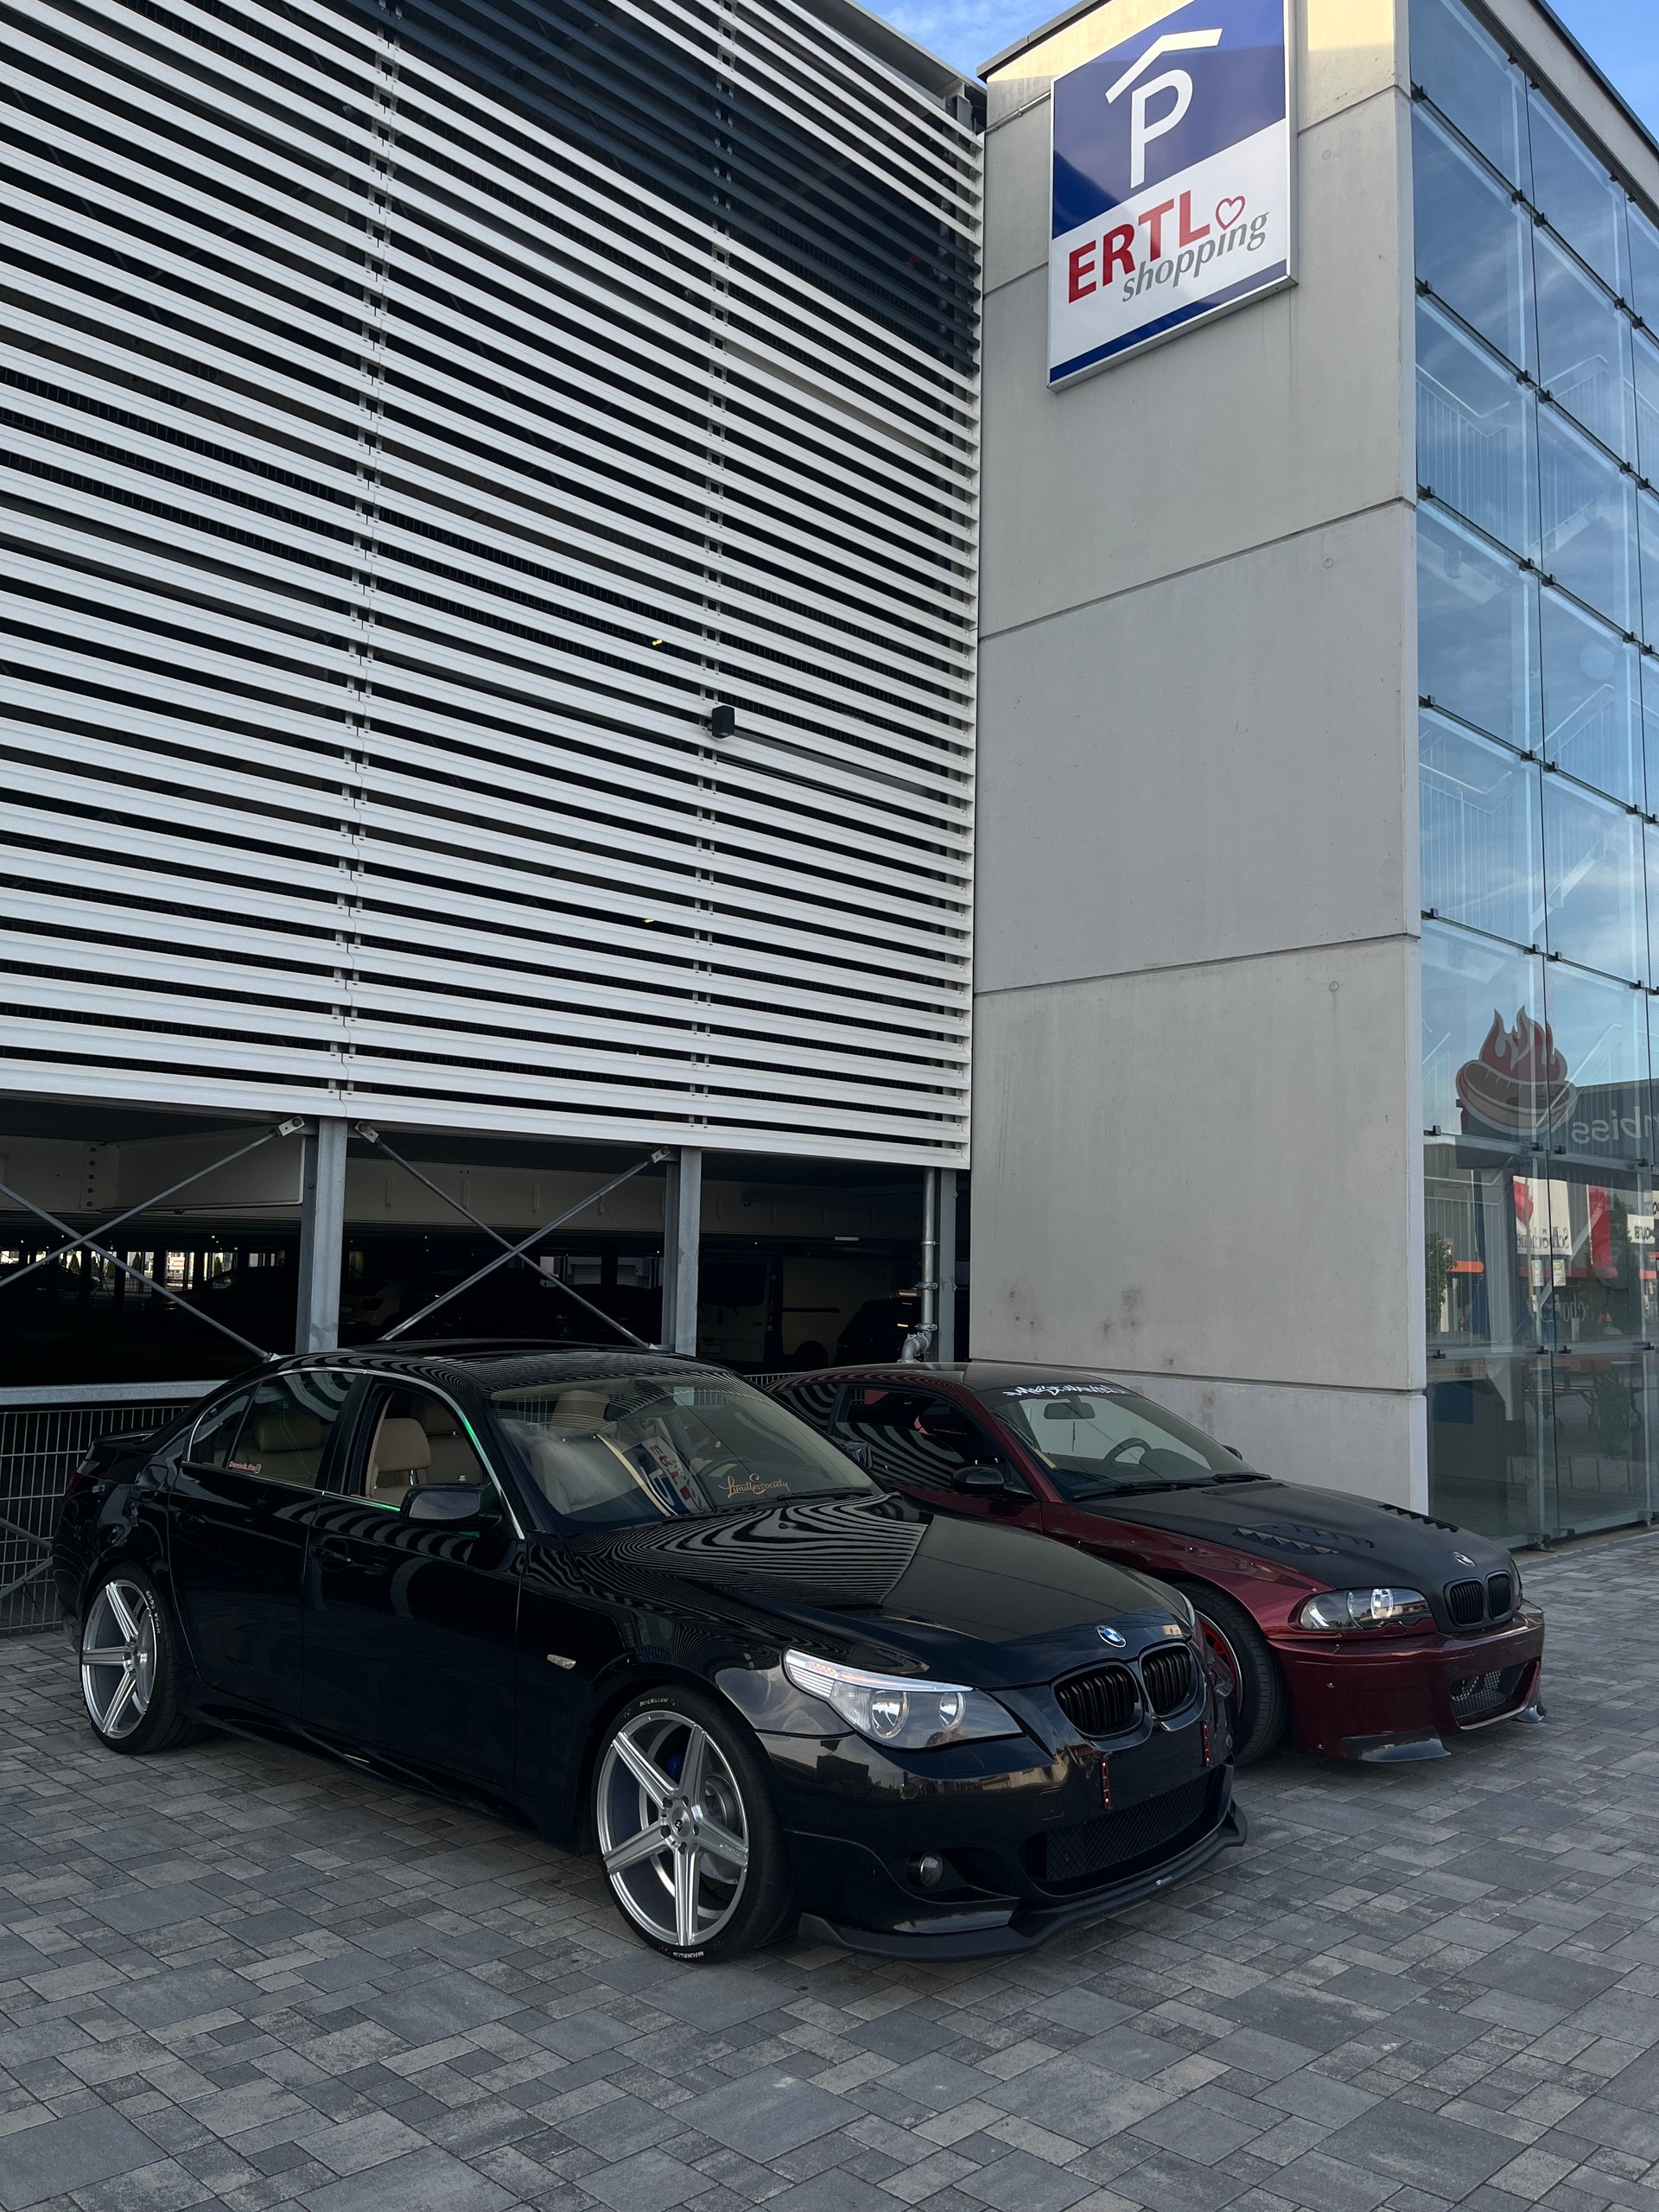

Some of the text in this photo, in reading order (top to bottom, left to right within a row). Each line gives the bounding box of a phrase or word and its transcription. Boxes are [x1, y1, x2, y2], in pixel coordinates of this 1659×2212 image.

[1131, 69, 1193, 189] P
[1069, 191, 1211, 303] ERTL
[1122, 212, 1269, 303] shopping
